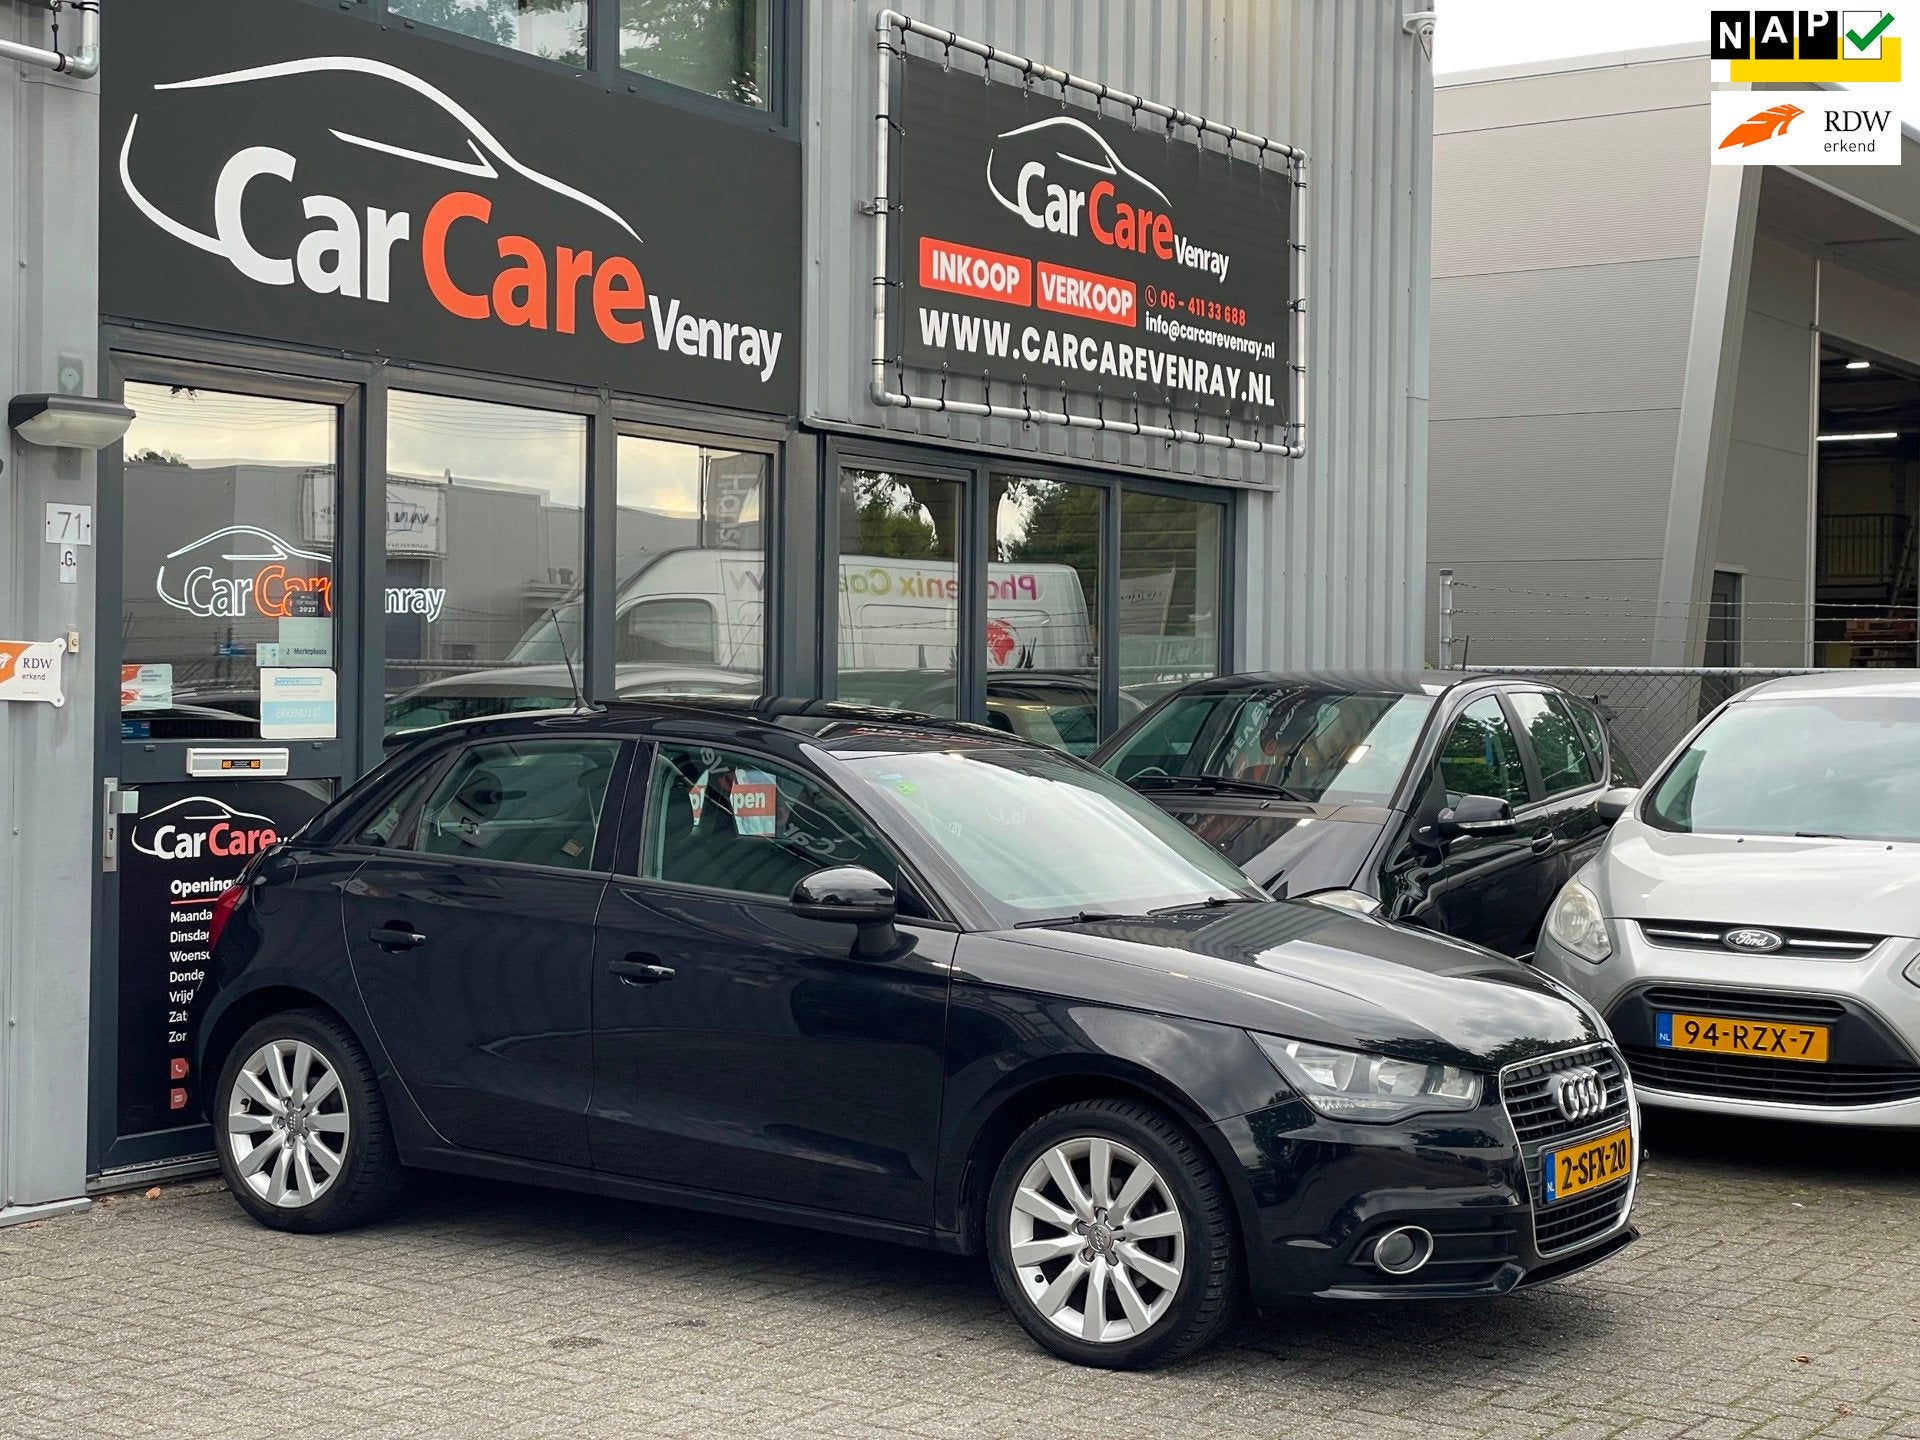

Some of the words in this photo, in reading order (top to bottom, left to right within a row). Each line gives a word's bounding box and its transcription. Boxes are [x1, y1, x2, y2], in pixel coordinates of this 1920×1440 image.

[932, 249, 1020, 294] INKOOP
[1174, 234, 1230, 283] Venray
[1040, 272, 1133, 317] VERKOOP
[1160, 289, 1175, 310] 06
[1188, 297, 1205, 317] 411
[1207, 301, 1221, 320] 33
[1224, 305, 1246, 327] 688
[648, 294, 782, 383] Venray
[1145, 310, 1275, 361] info@carcarevenray.nl
[919, 308, 1275, 407] WWW.CARCAREVENRAY.NL
[57, 511, 81, 540] 71
[22, 672, 46, 681] erkend
[23, 657, 53, 669] RDW
[731, 791, 766, 815] pen
[1735, 931, 1767, 947] Ford
[1659, 1032, 1671, 1042] NL
[1684, 1020, 1815, 1055] 94-RZX-7
[1561, 1138, 1627, 1191] 2-SFX-20
